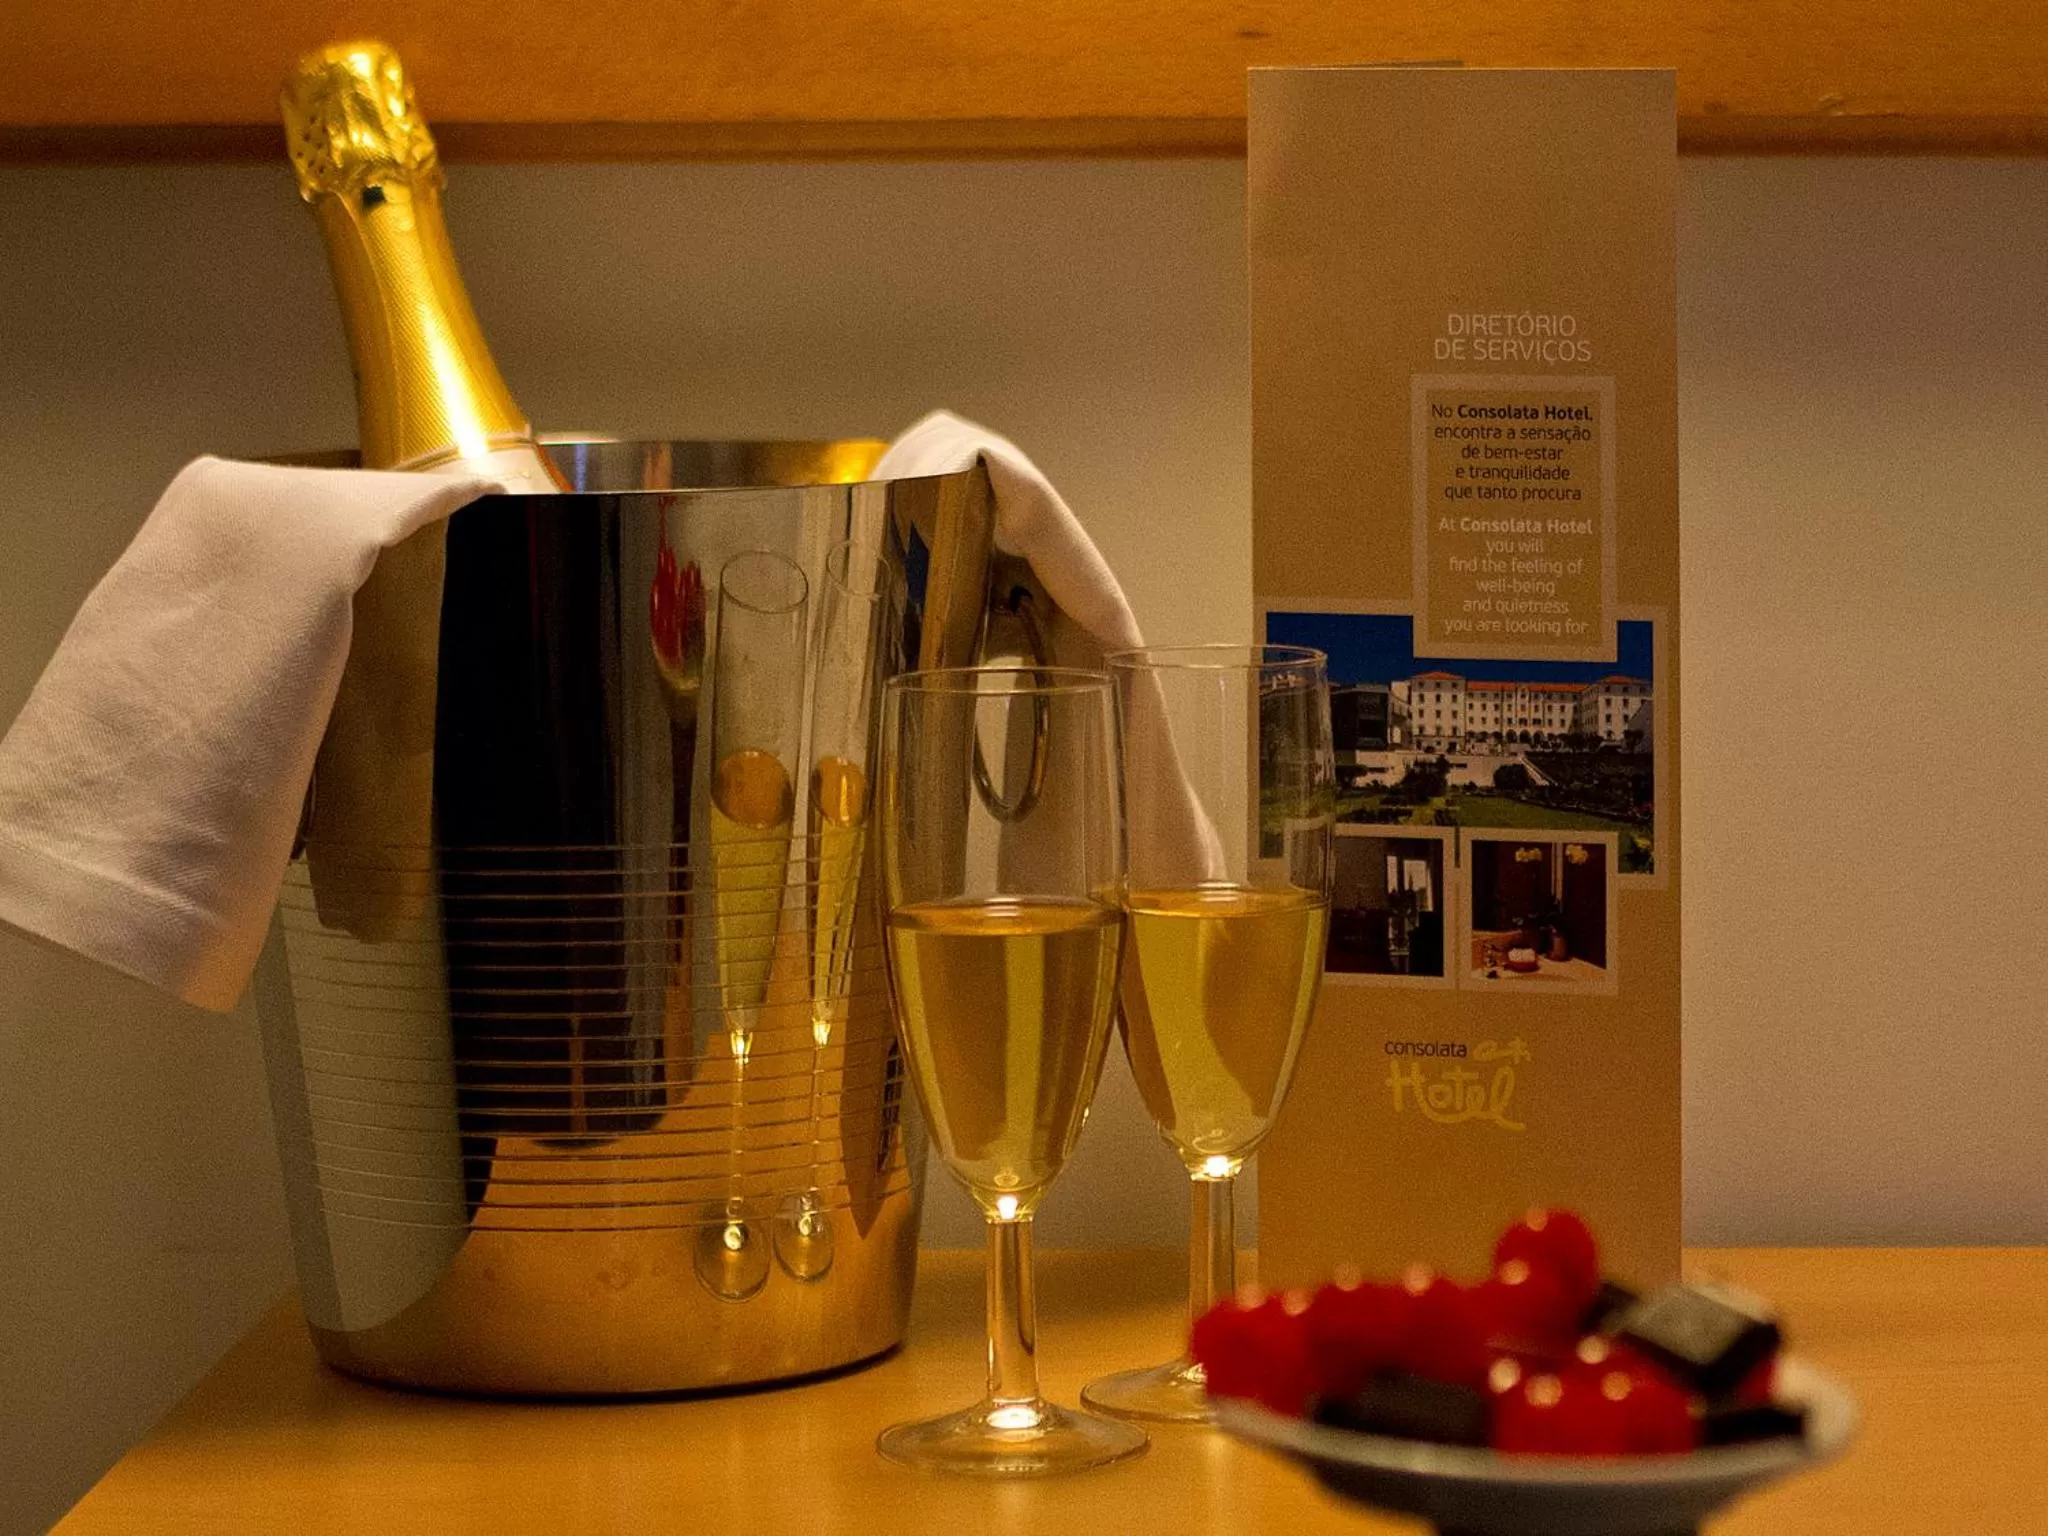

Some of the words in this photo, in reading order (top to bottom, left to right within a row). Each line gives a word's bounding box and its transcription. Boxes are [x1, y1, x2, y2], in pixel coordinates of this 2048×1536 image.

[1447, 311, 1577, 337] DIRETÓRIO
[1434, 338, 1466, 361] DE
[1473, 339, 1592, 365] SERVIÇOS
[1431, 404, 1453, 420] No
[1457, 404, 1540, 421] Consolata
[1434, 426, 1503, 439] encontra
[1507, 428, 1516, 440] a
[1519, 425, 1592, 444] sensação
[1461, 444, 1481, 460] de
[1484, 445, 1564, 461] bem-estar
[1455, 467, 1465, 479] e
[1469, 465, 1571, 482] tranquilidade
[1444, 486, 1473, 502] que
[1477, 487, 1519, 500] tanto
[1522, 489, 1582, 504] procura
[1439, 518, 1457, 532] At
[1460, 517, 1542, 533] Consolata
[1547, 519, 1593, 535] Hotel
[1486, 538, 1515, 556] you
[1518, 537, 1544, 553] will
[1450, 556, 1478, 573] find
[1482, 557, 1507, 573] the
[1511, 557, 1564, 577] feeling
[1567, 558, 1584, 575] of
[1475, 579, 1556, 597] well-being
[1463, 598, 1492, 613] and
[1496, 599, 1569, 615] quietness
[1444, 619, 1472, 636] you
[1475, 621, 1500, 632] are
[1505, 619, 1562, 637] looking
[1564, 618, 1590, 634] for
[1384, 1040, 1468, 1058] consolata
